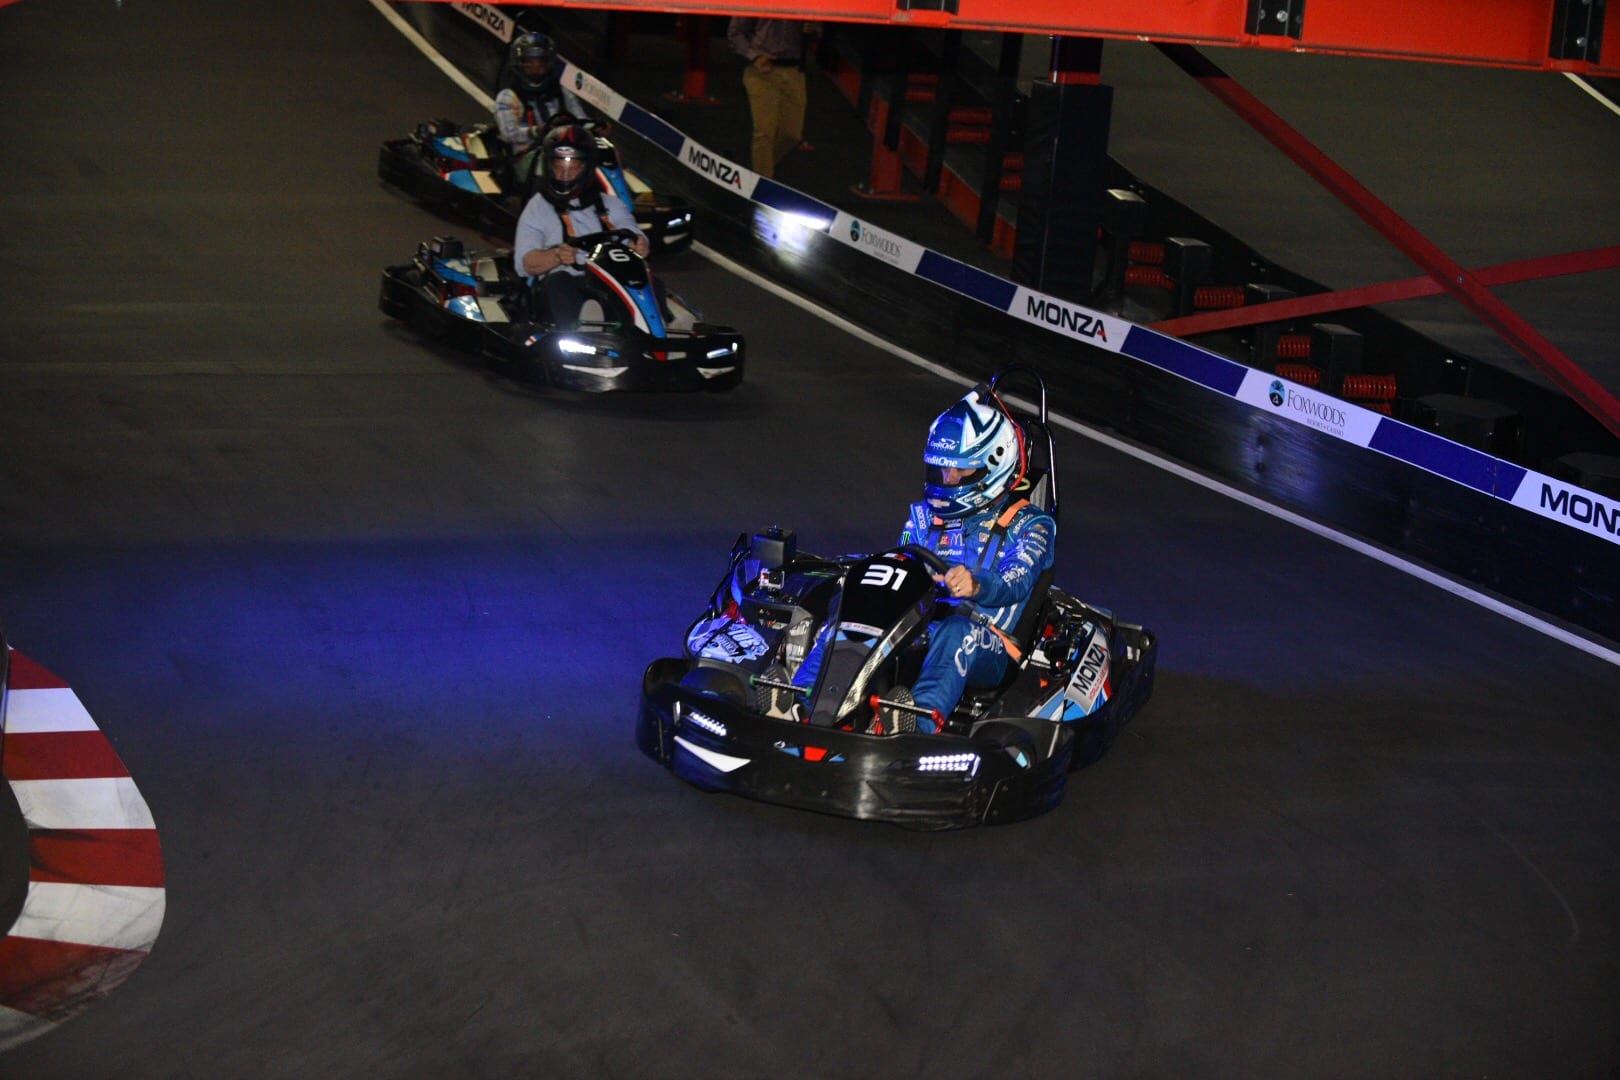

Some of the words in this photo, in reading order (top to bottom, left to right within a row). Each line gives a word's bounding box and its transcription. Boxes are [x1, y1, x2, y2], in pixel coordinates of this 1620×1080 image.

[688, 146, 742, 190] MONZA
[608, 249, 630, 262] 6
[1027, 295, 1108, 342] MONZA
[1287, 389, 1346, 427] FOXWOODS
[860, 564, 908, 591] 31
[1072, 643, 1109, 696] MONZA
